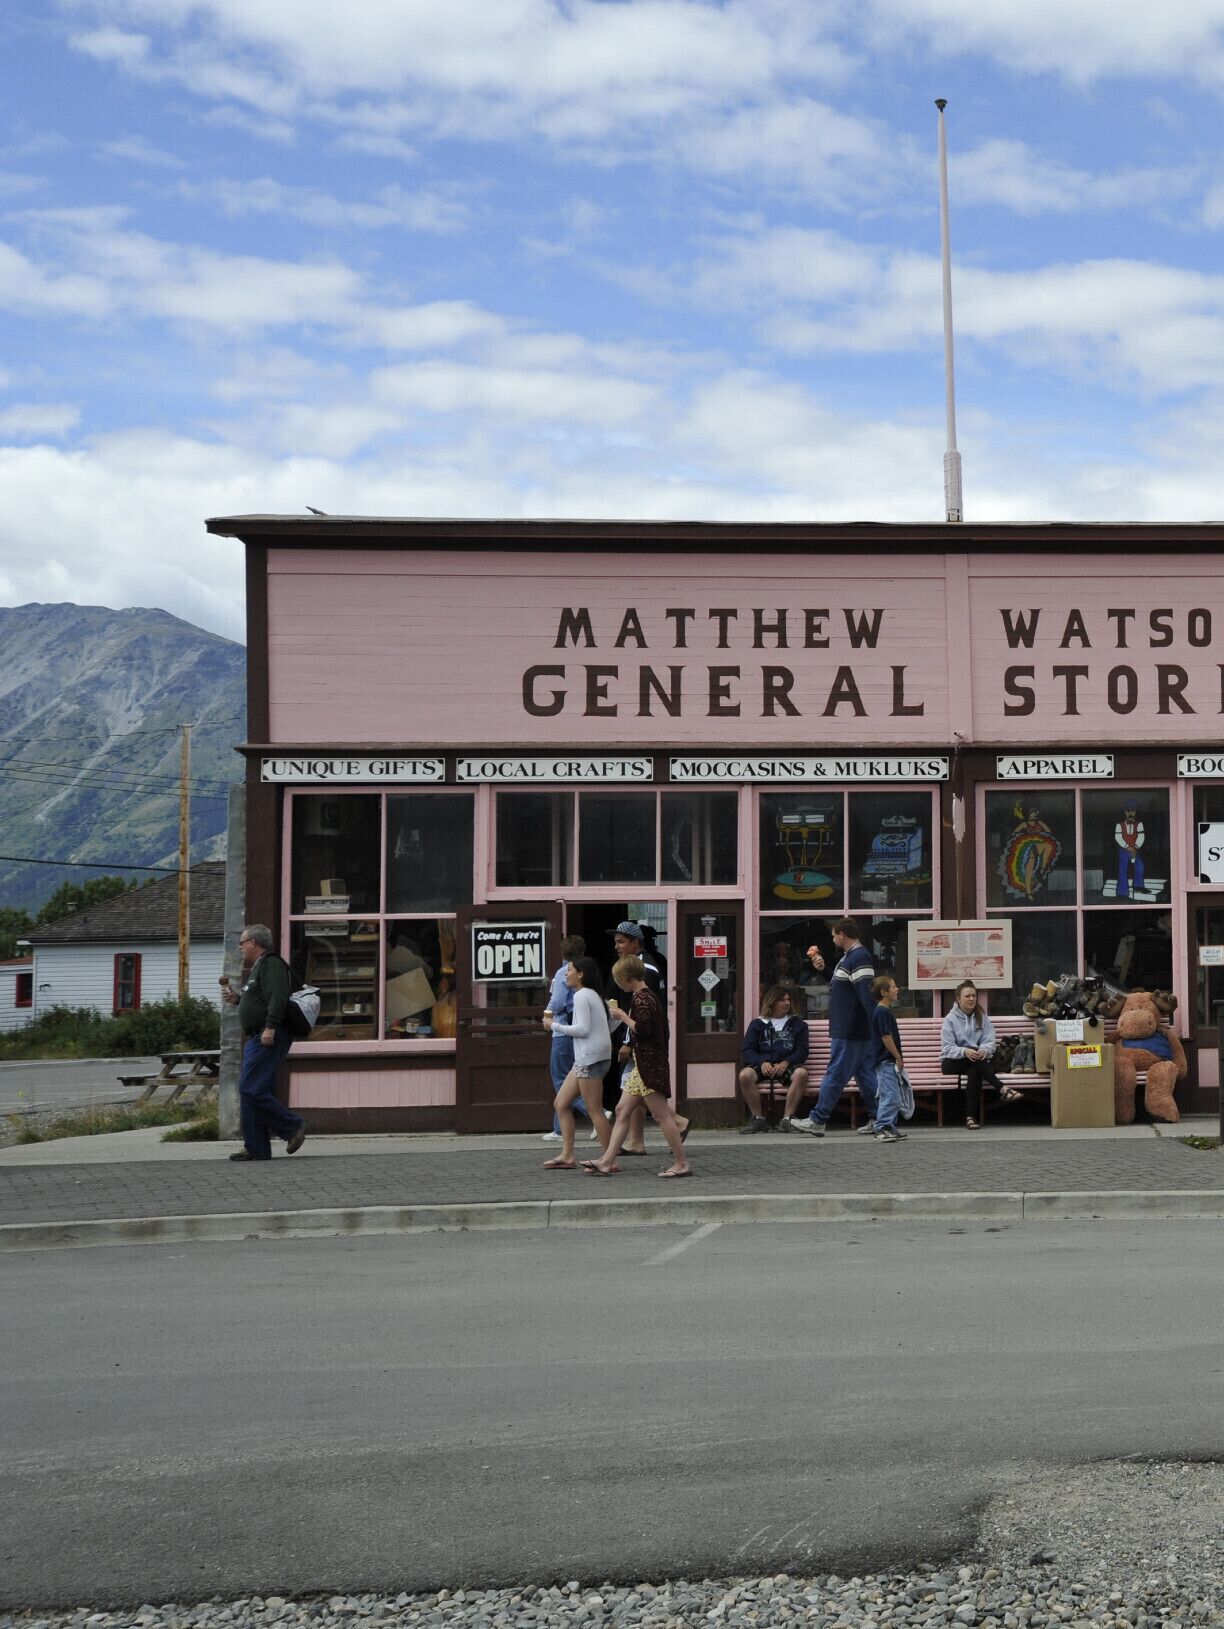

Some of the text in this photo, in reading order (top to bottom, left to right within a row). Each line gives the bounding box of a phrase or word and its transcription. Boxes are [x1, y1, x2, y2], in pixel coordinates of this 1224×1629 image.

[554, 607, 885, 649] MATTHEW
[522, 664, 925, 717] GENERAL
[271, 760, 437, 778] UNIQUE GIFTS
[466, 761, 645, 777] LOCAL CRAFTS
[679, 761, 941, 777] MOCCASINS & MUKLUKS
[1006, 759, 1105, 775] APPAREL
[477, 930, 540, 941] Come in, we're
[477, 943, 540, 975] OPEN
